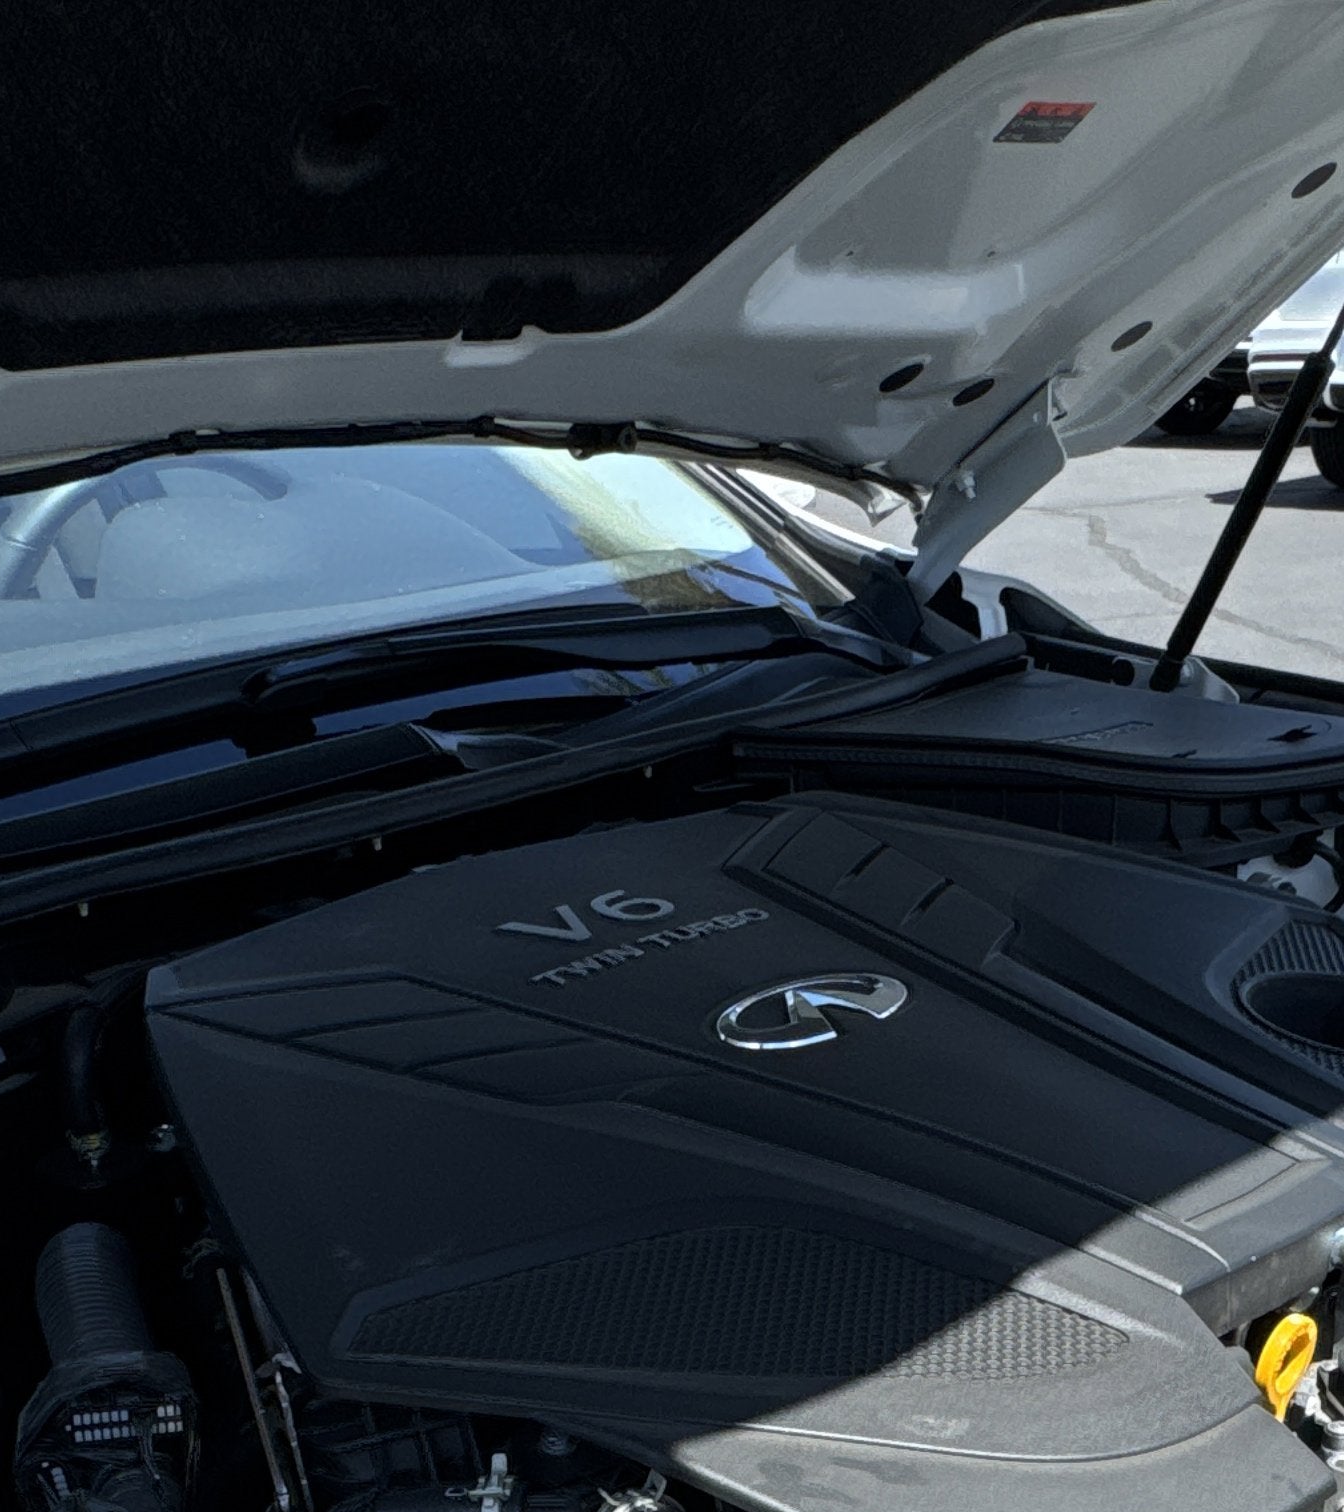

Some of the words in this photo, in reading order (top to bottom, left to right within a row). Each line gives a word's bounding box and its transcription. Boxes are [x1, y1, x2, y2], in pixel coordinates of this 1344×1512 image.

[495, 888, 675, 943] V6
[529, 943, 645, 987] TWIN
[638, 908, 769, 950] TURBO
